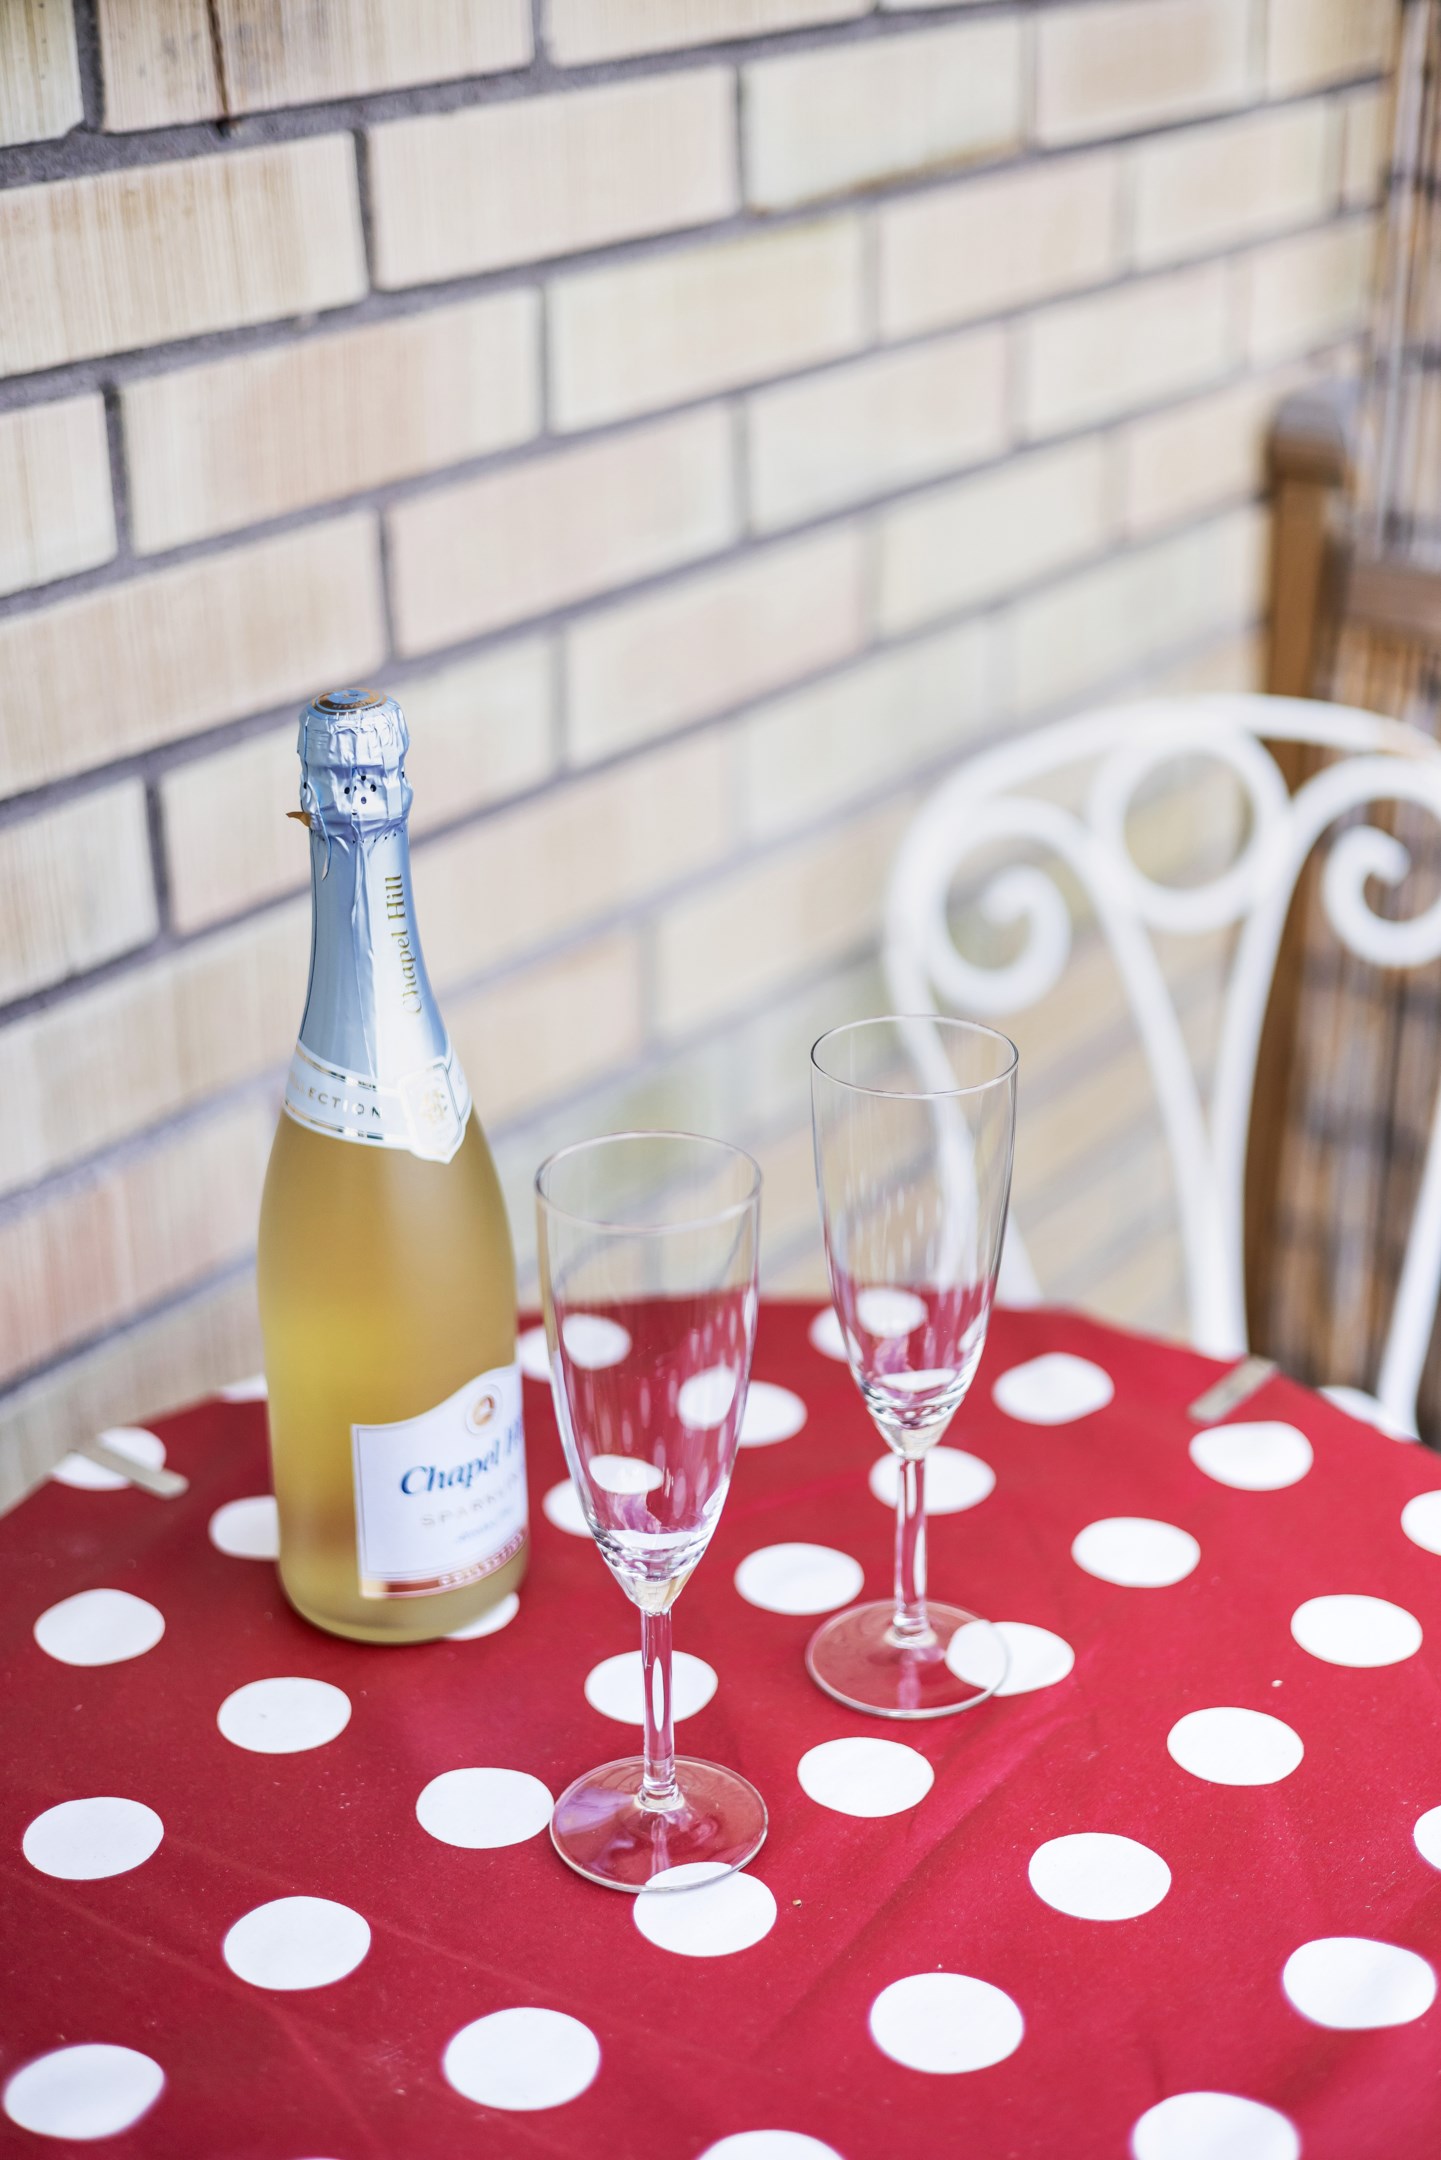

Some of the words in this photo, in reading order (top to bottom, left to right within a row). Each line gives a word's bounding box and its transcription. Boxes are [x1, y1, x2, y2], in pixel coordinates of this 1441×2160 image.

[385, 873, 406, 920] Hill
[391, 929, 423, 1015] Chapel
[400, 1438, 500, 1495] Chapel
